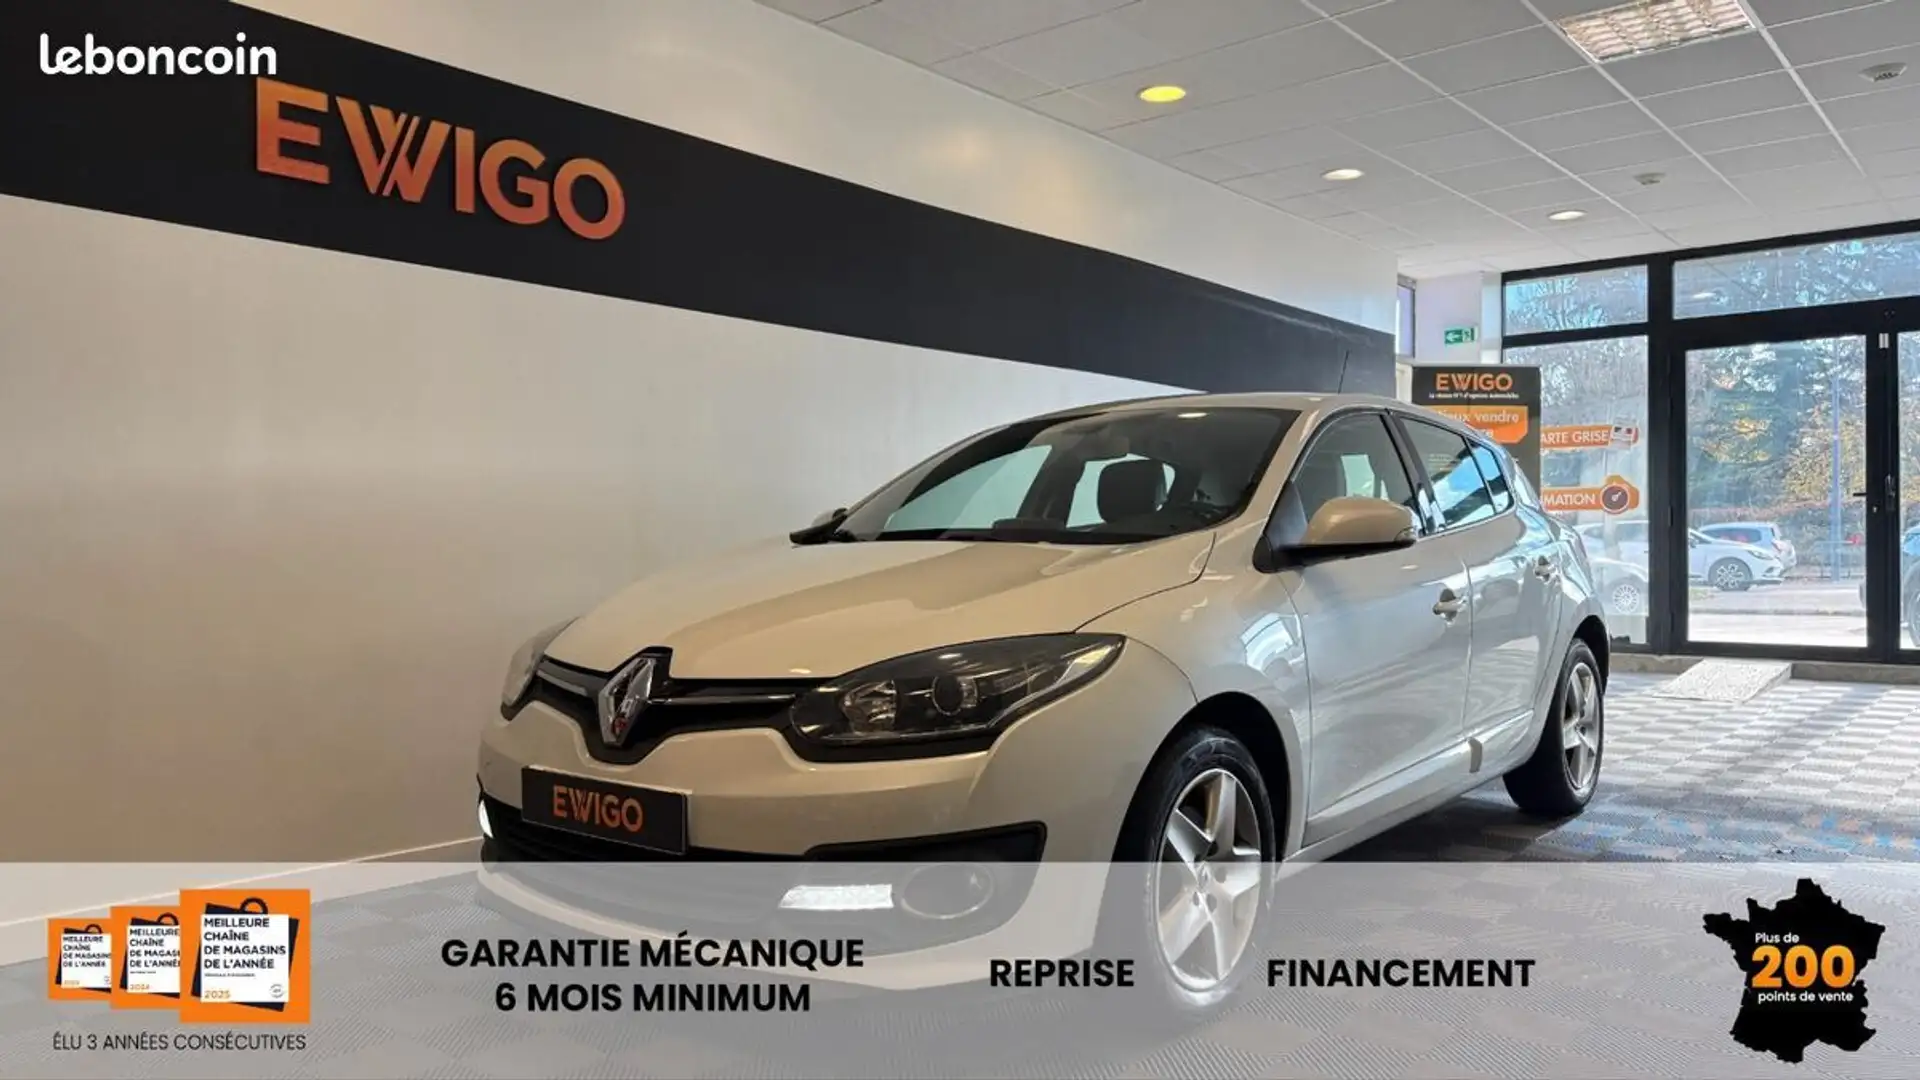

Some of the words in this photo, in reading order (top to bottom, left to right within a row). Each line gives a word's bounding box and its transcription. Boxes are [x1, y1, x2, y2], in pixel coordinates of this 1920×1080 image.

[256, 77, 626, 240] EWIGO
[1435, 373, 1513, 391] EWIGO
[1475, 409, 1519, 423] vendre
[1572, 430, 1609, 443] GRISE
[552, 785, 643, 832] EWIGO
